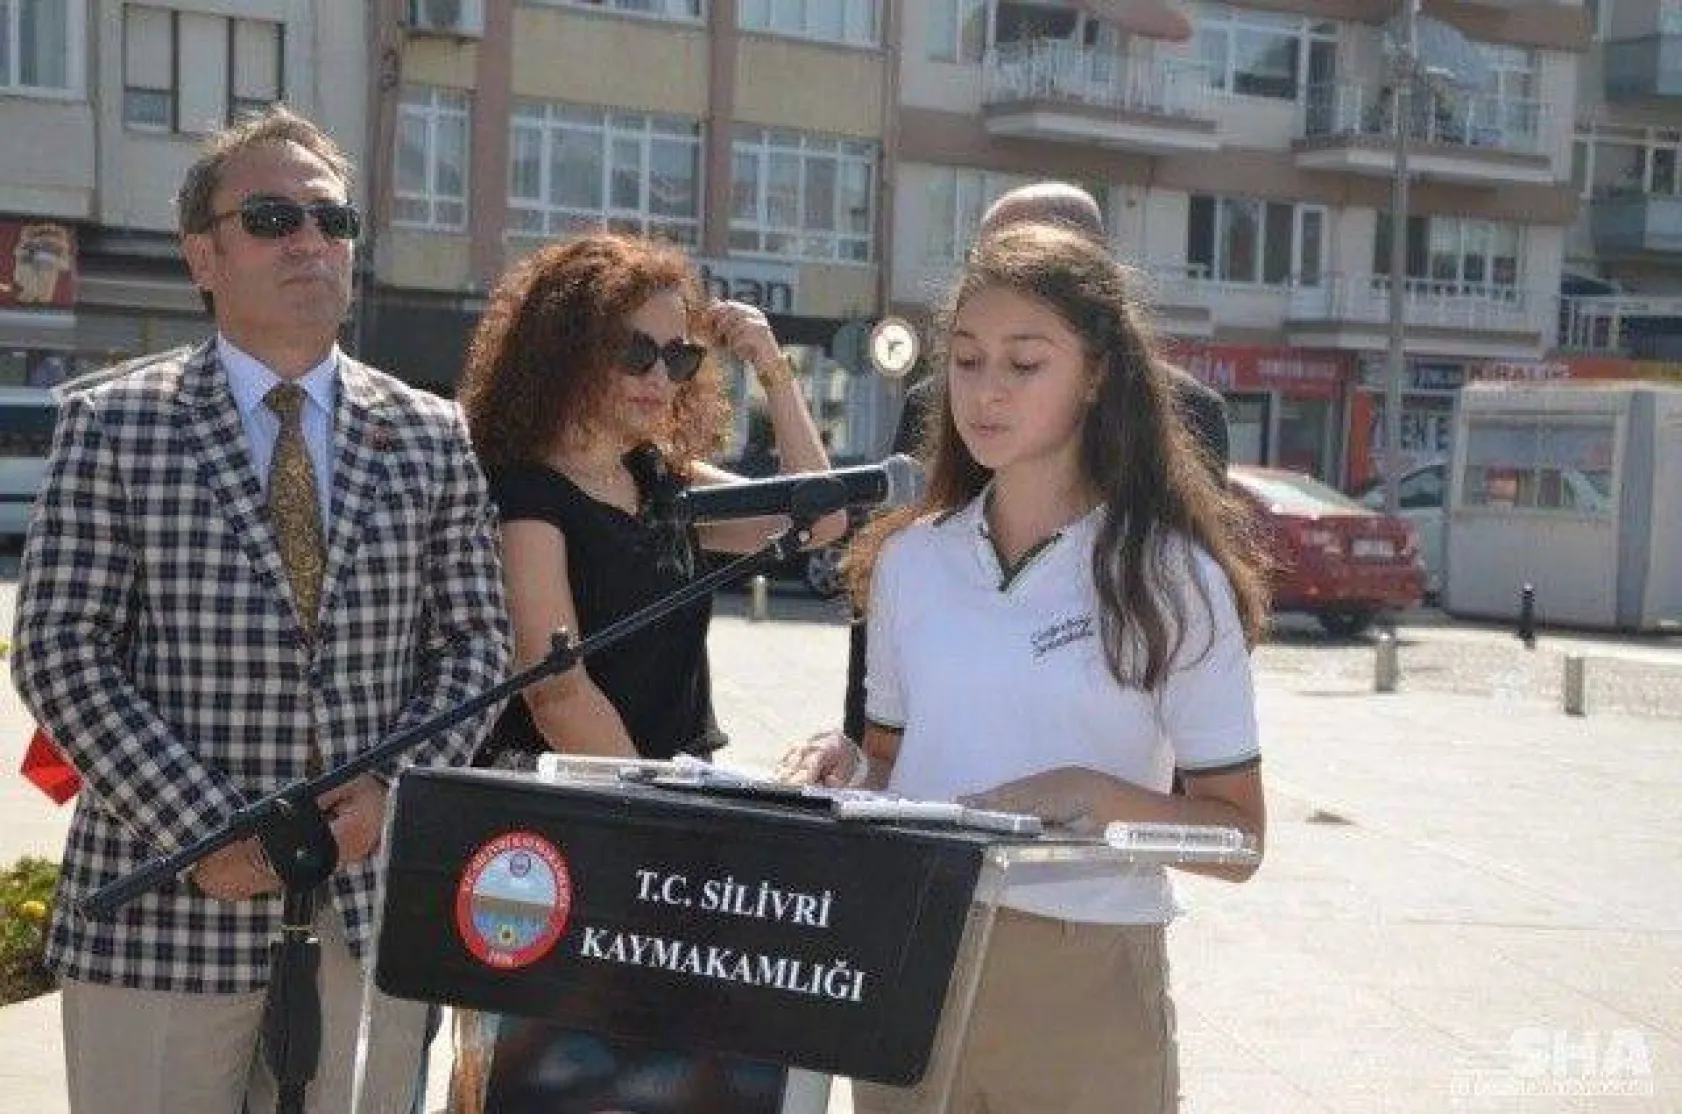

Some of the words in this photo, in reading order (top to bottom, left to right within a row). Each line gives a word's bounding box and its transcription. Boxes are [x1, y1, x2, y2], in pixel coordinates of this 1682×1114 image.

[636, 869, 692, 908] T.C.
[701, 874, 833, 929] SİLİVRİ
[580, 926, 866, 1002] KAYMAKAMLIĞI
